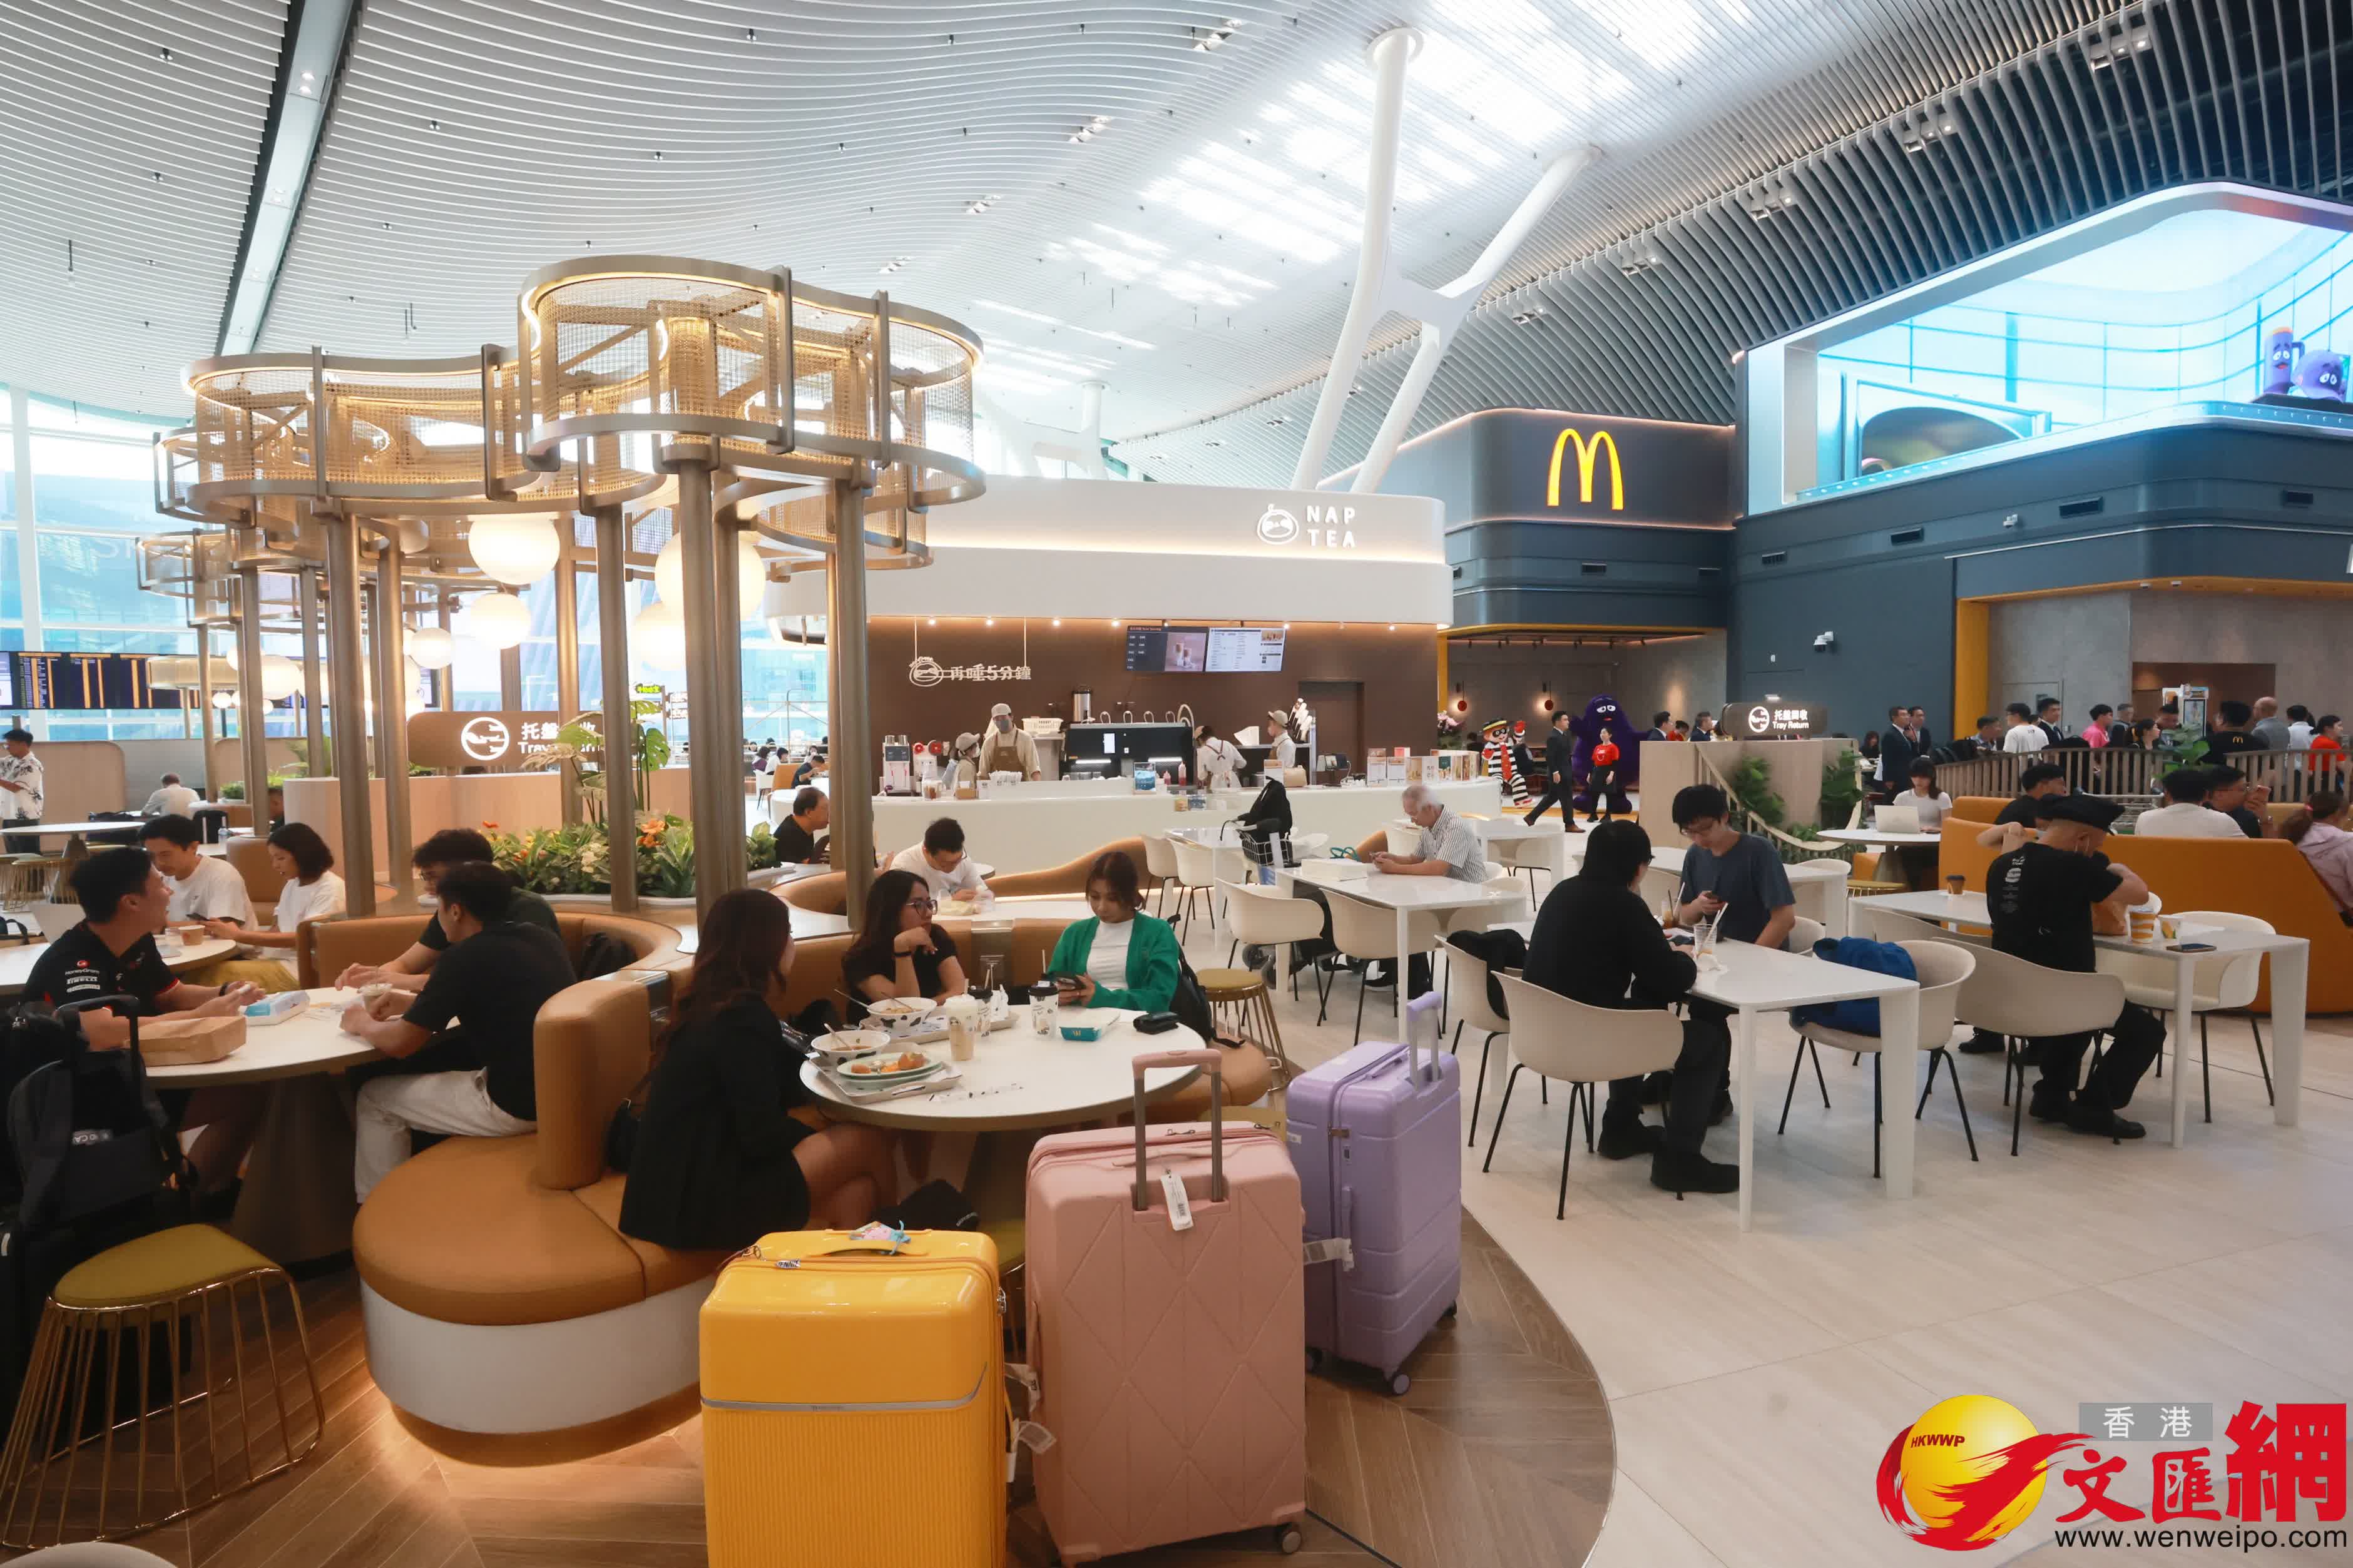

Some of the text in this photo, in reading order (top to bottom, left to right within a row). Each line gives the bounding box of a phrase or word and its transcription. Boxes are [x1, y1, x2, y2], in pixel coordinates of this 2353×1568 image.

[1547, 428, 1623, 511] M
[1307, 505, 1355, 524] NAP
[1307, 529, 1355, 547] TEA
[1774, 709, 1808, 720] 托盤回收
[1772, 721, 1787, 730] Tray
